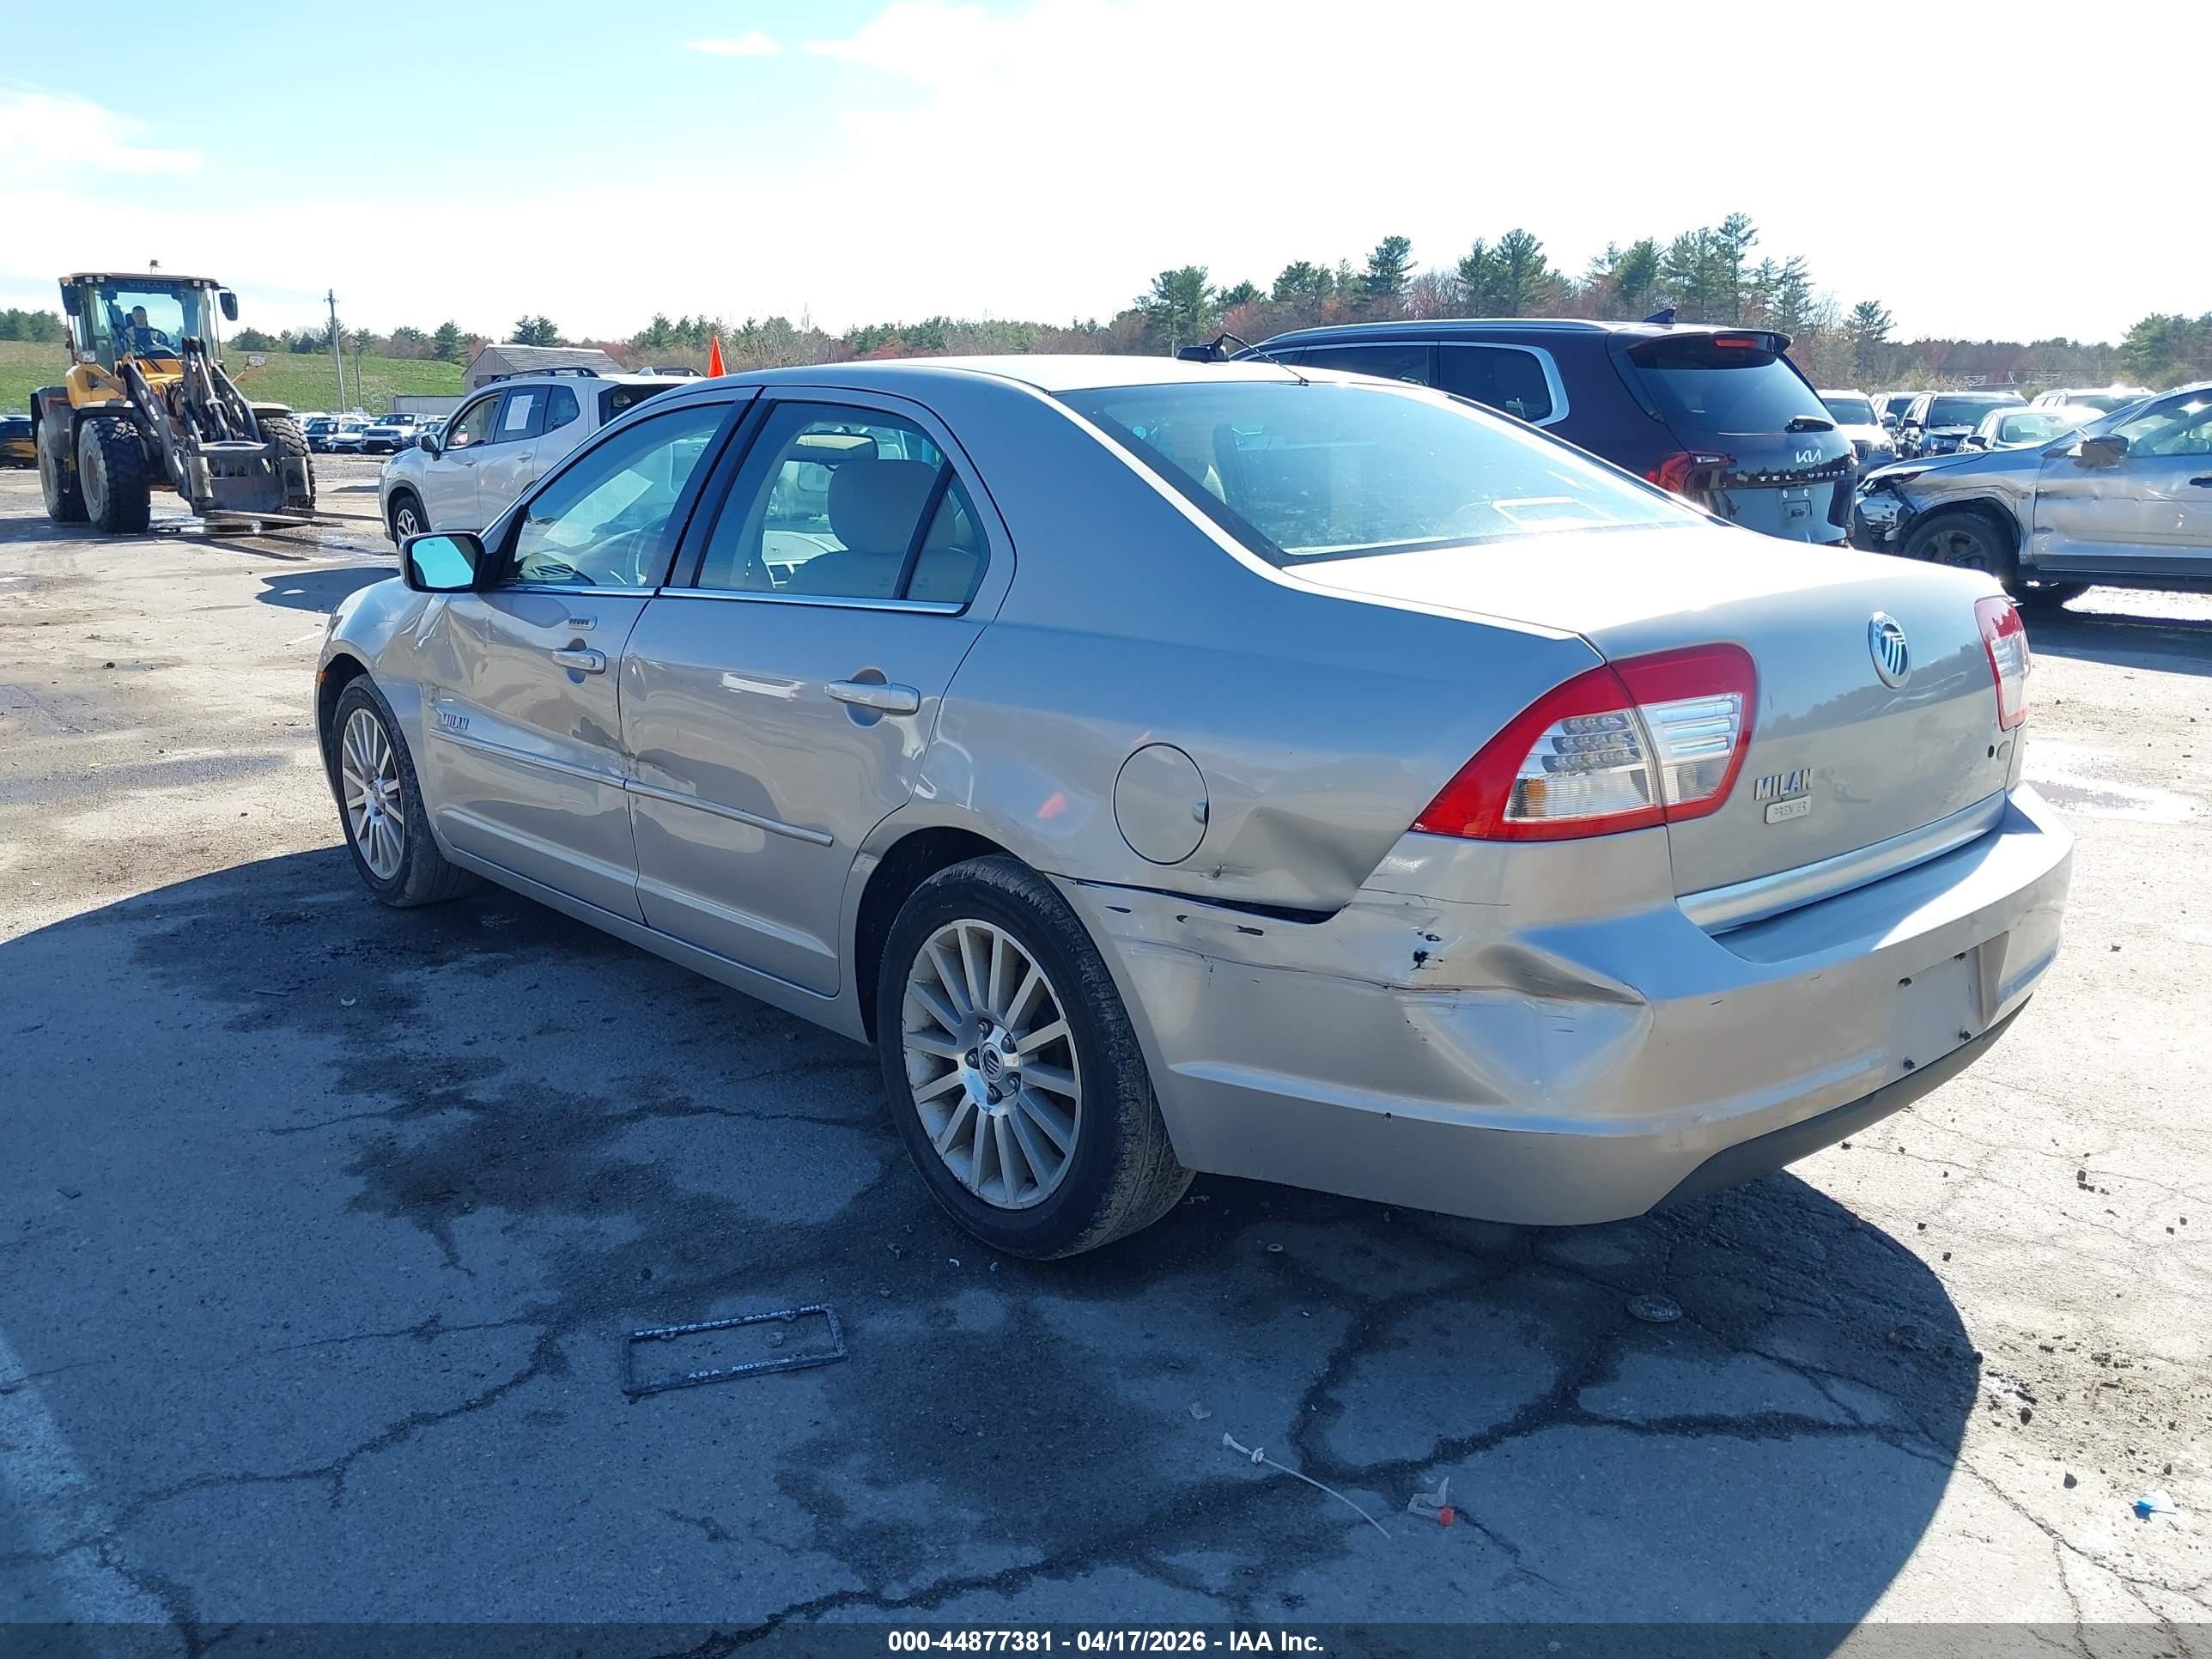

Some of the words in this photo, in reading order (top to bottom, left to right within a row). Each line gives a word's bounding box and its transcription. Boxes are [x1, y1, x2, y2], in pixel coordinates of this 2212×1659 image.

[126, 281, 172, 289] VOLVO
[1758, 470, 1845, 482] TELURIDE
[1754, 769, 1814, 801] MILAN
